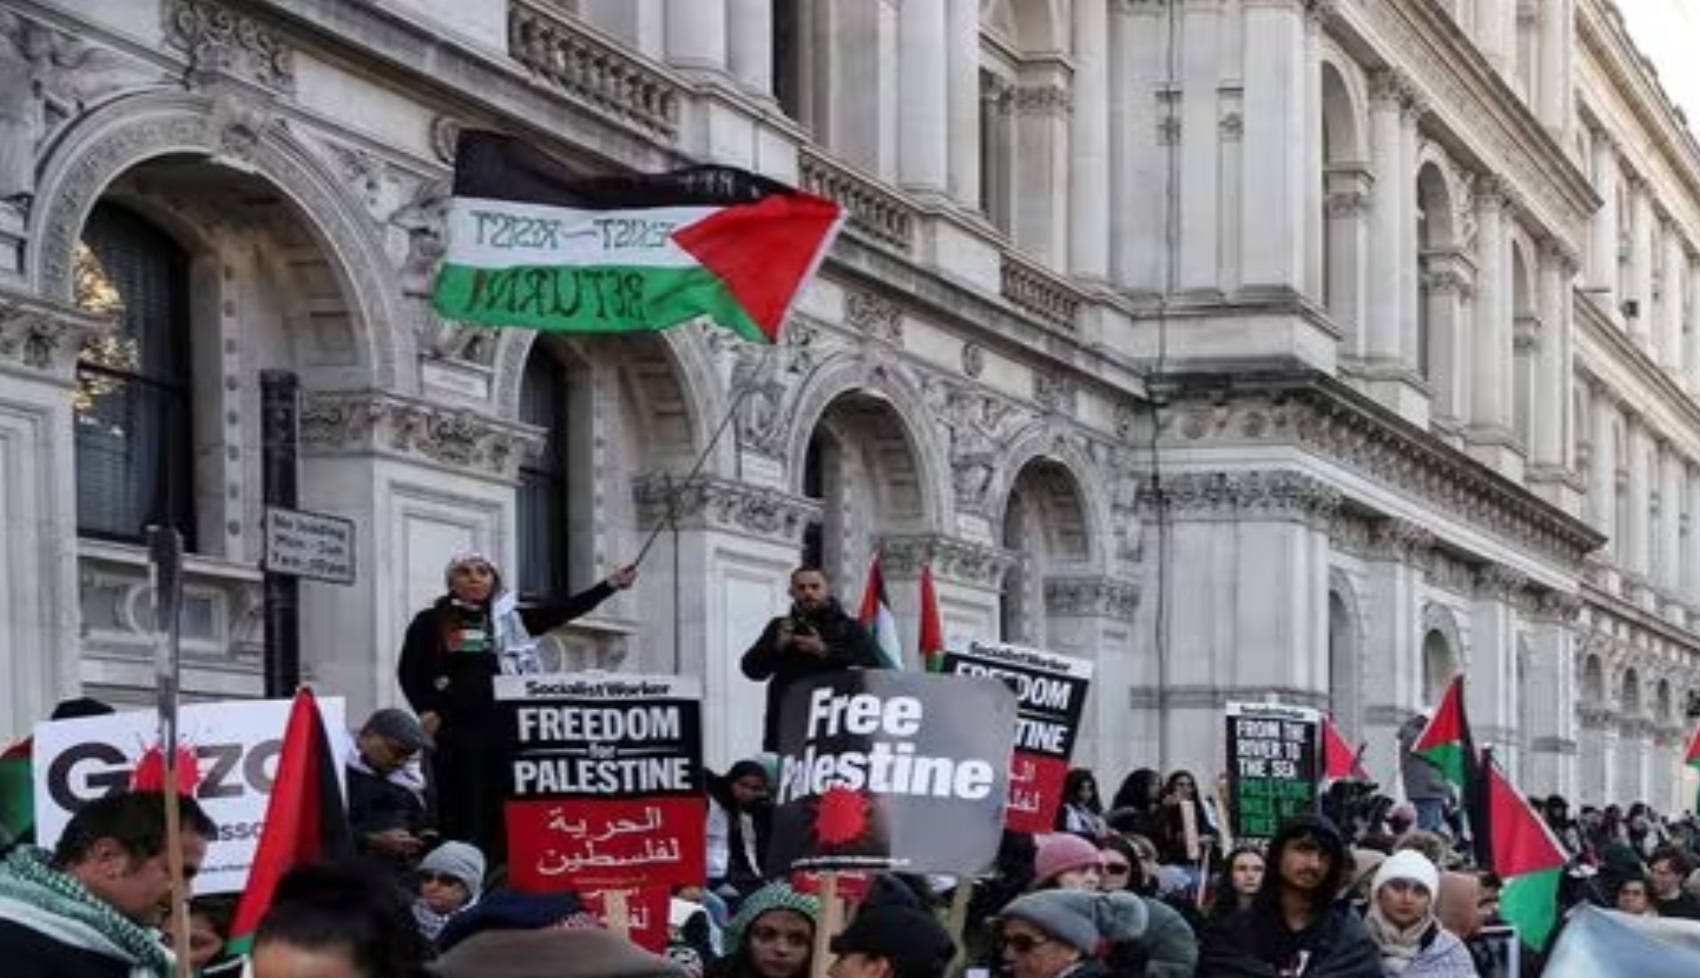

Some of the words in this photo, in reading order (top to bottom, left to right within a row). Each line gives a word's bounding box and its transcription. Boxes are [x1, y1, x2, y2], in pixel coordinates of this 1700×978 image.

[517, 707, 680, 742] FREEDOM
[808, 687, 923, 738] Free
[513, 757, 692, 795] PALESTINE
[548, 806, 662, 842] الحرية
[536, 837, 681, 875] لفلسطين
